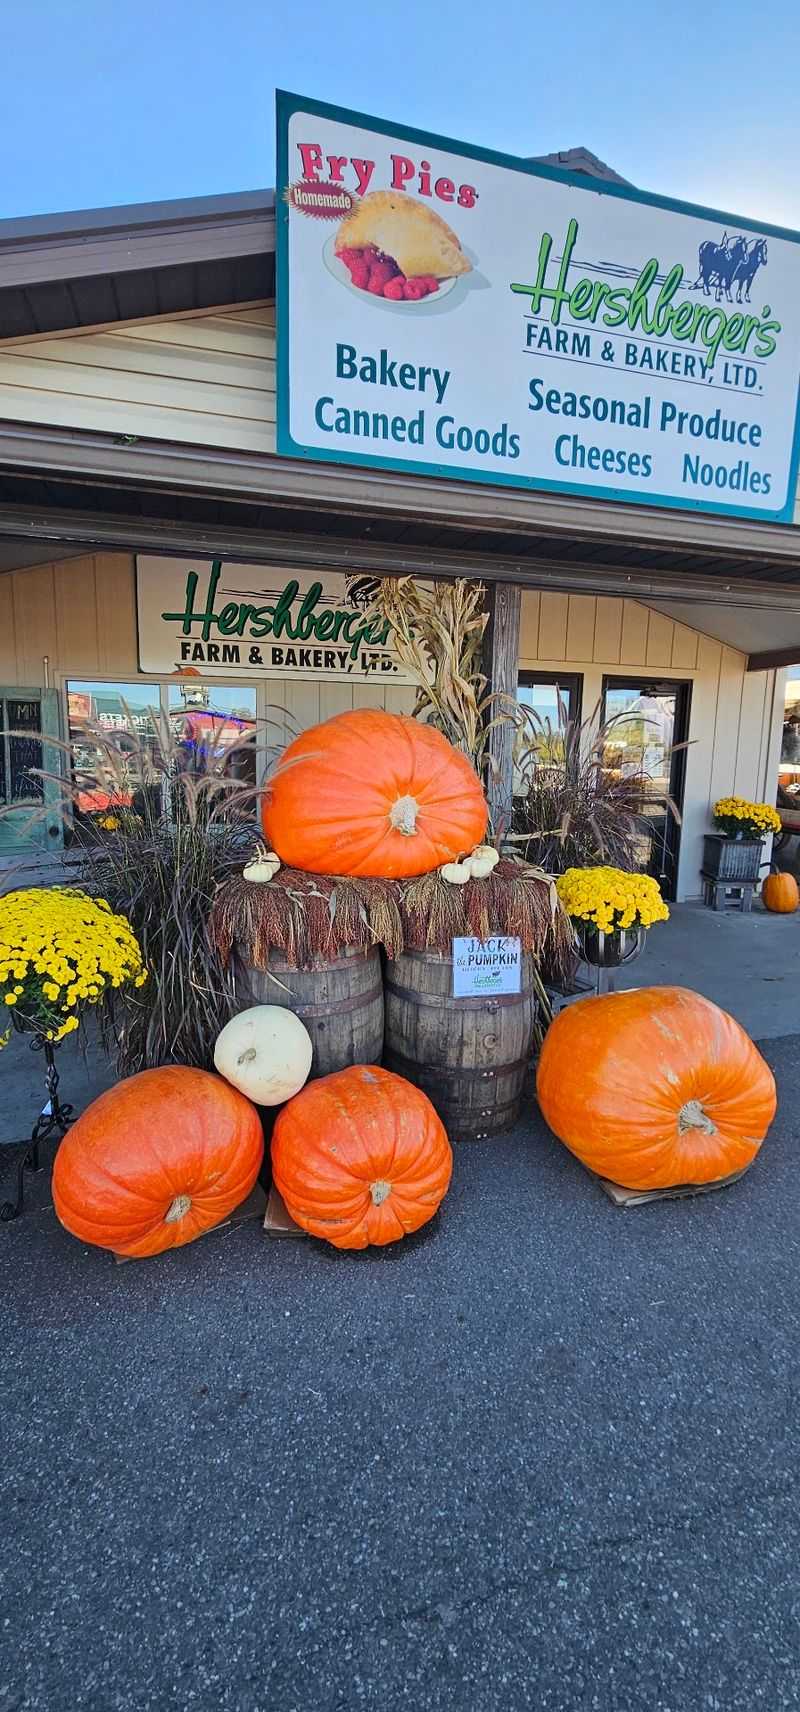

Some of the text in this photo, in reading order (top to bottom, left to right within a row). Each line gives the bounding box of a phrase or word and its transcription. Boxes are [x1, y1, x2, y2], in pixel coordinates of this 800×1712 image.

[294, 188, 352, 209] Homemade
[297, 143, 478, 208] Fry Pies
[510, 218, 781, 368] Hershberger's
[336, 343, 451, 404] Bakery
[526, 323, 763, 390] FARM & BAKERY, LTD.
[314, 396, 521, 459] Canned Goods
[528, 379, 762, 447] Seasonal Produce
[554, 434, 652, 478] Cheeses
[682, 453, 772, 495] Noodles
[180, 642, 398, 673] FARM & BAKERY, LTD.
[468, 939, 506, 953] JACK
[468, 953, 518, 966] PUMPKIN
